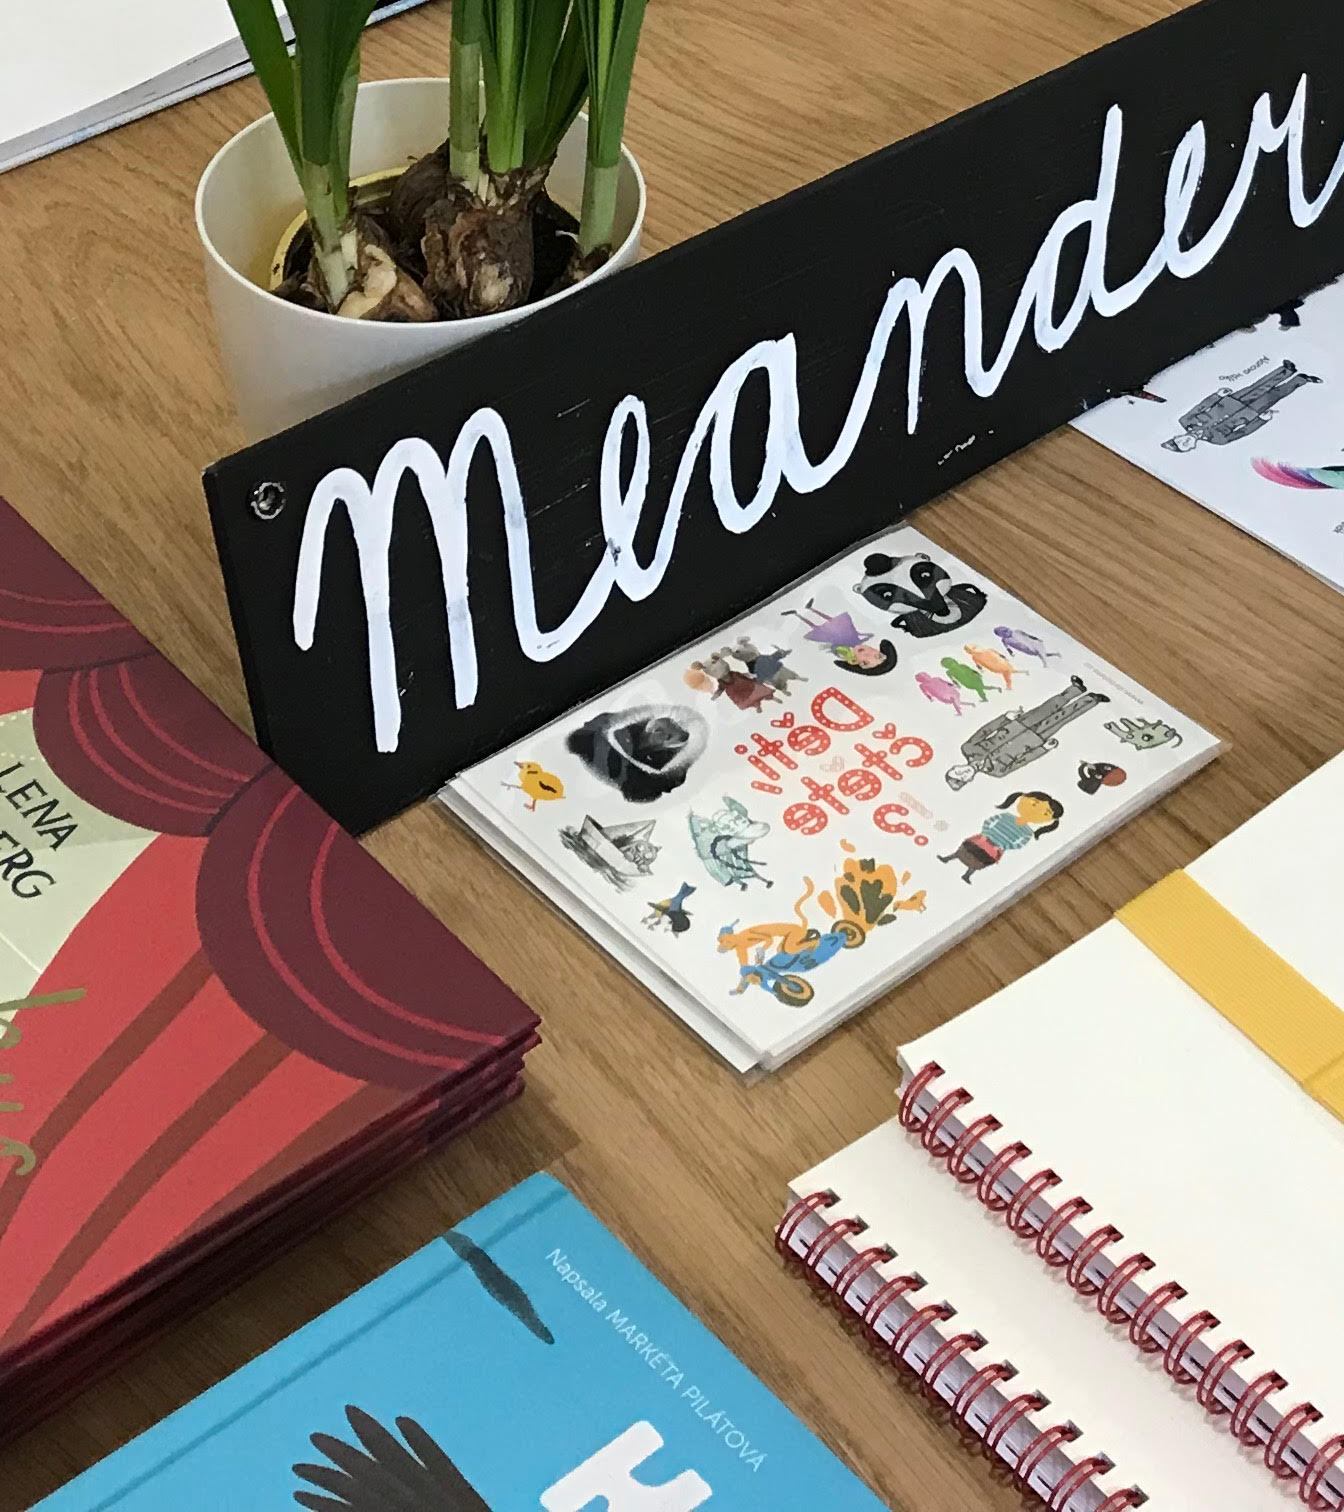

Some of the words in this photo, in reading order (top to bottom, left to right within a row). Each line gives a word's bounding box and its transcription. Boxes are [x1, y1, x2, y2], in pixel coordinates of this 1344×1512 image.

[545, 1248, 608, 1312] Napsala
[604, 1309, 686, 1390] MARKÉTA
[681, 1385, 768, 1473] PILÁTOVÁ
